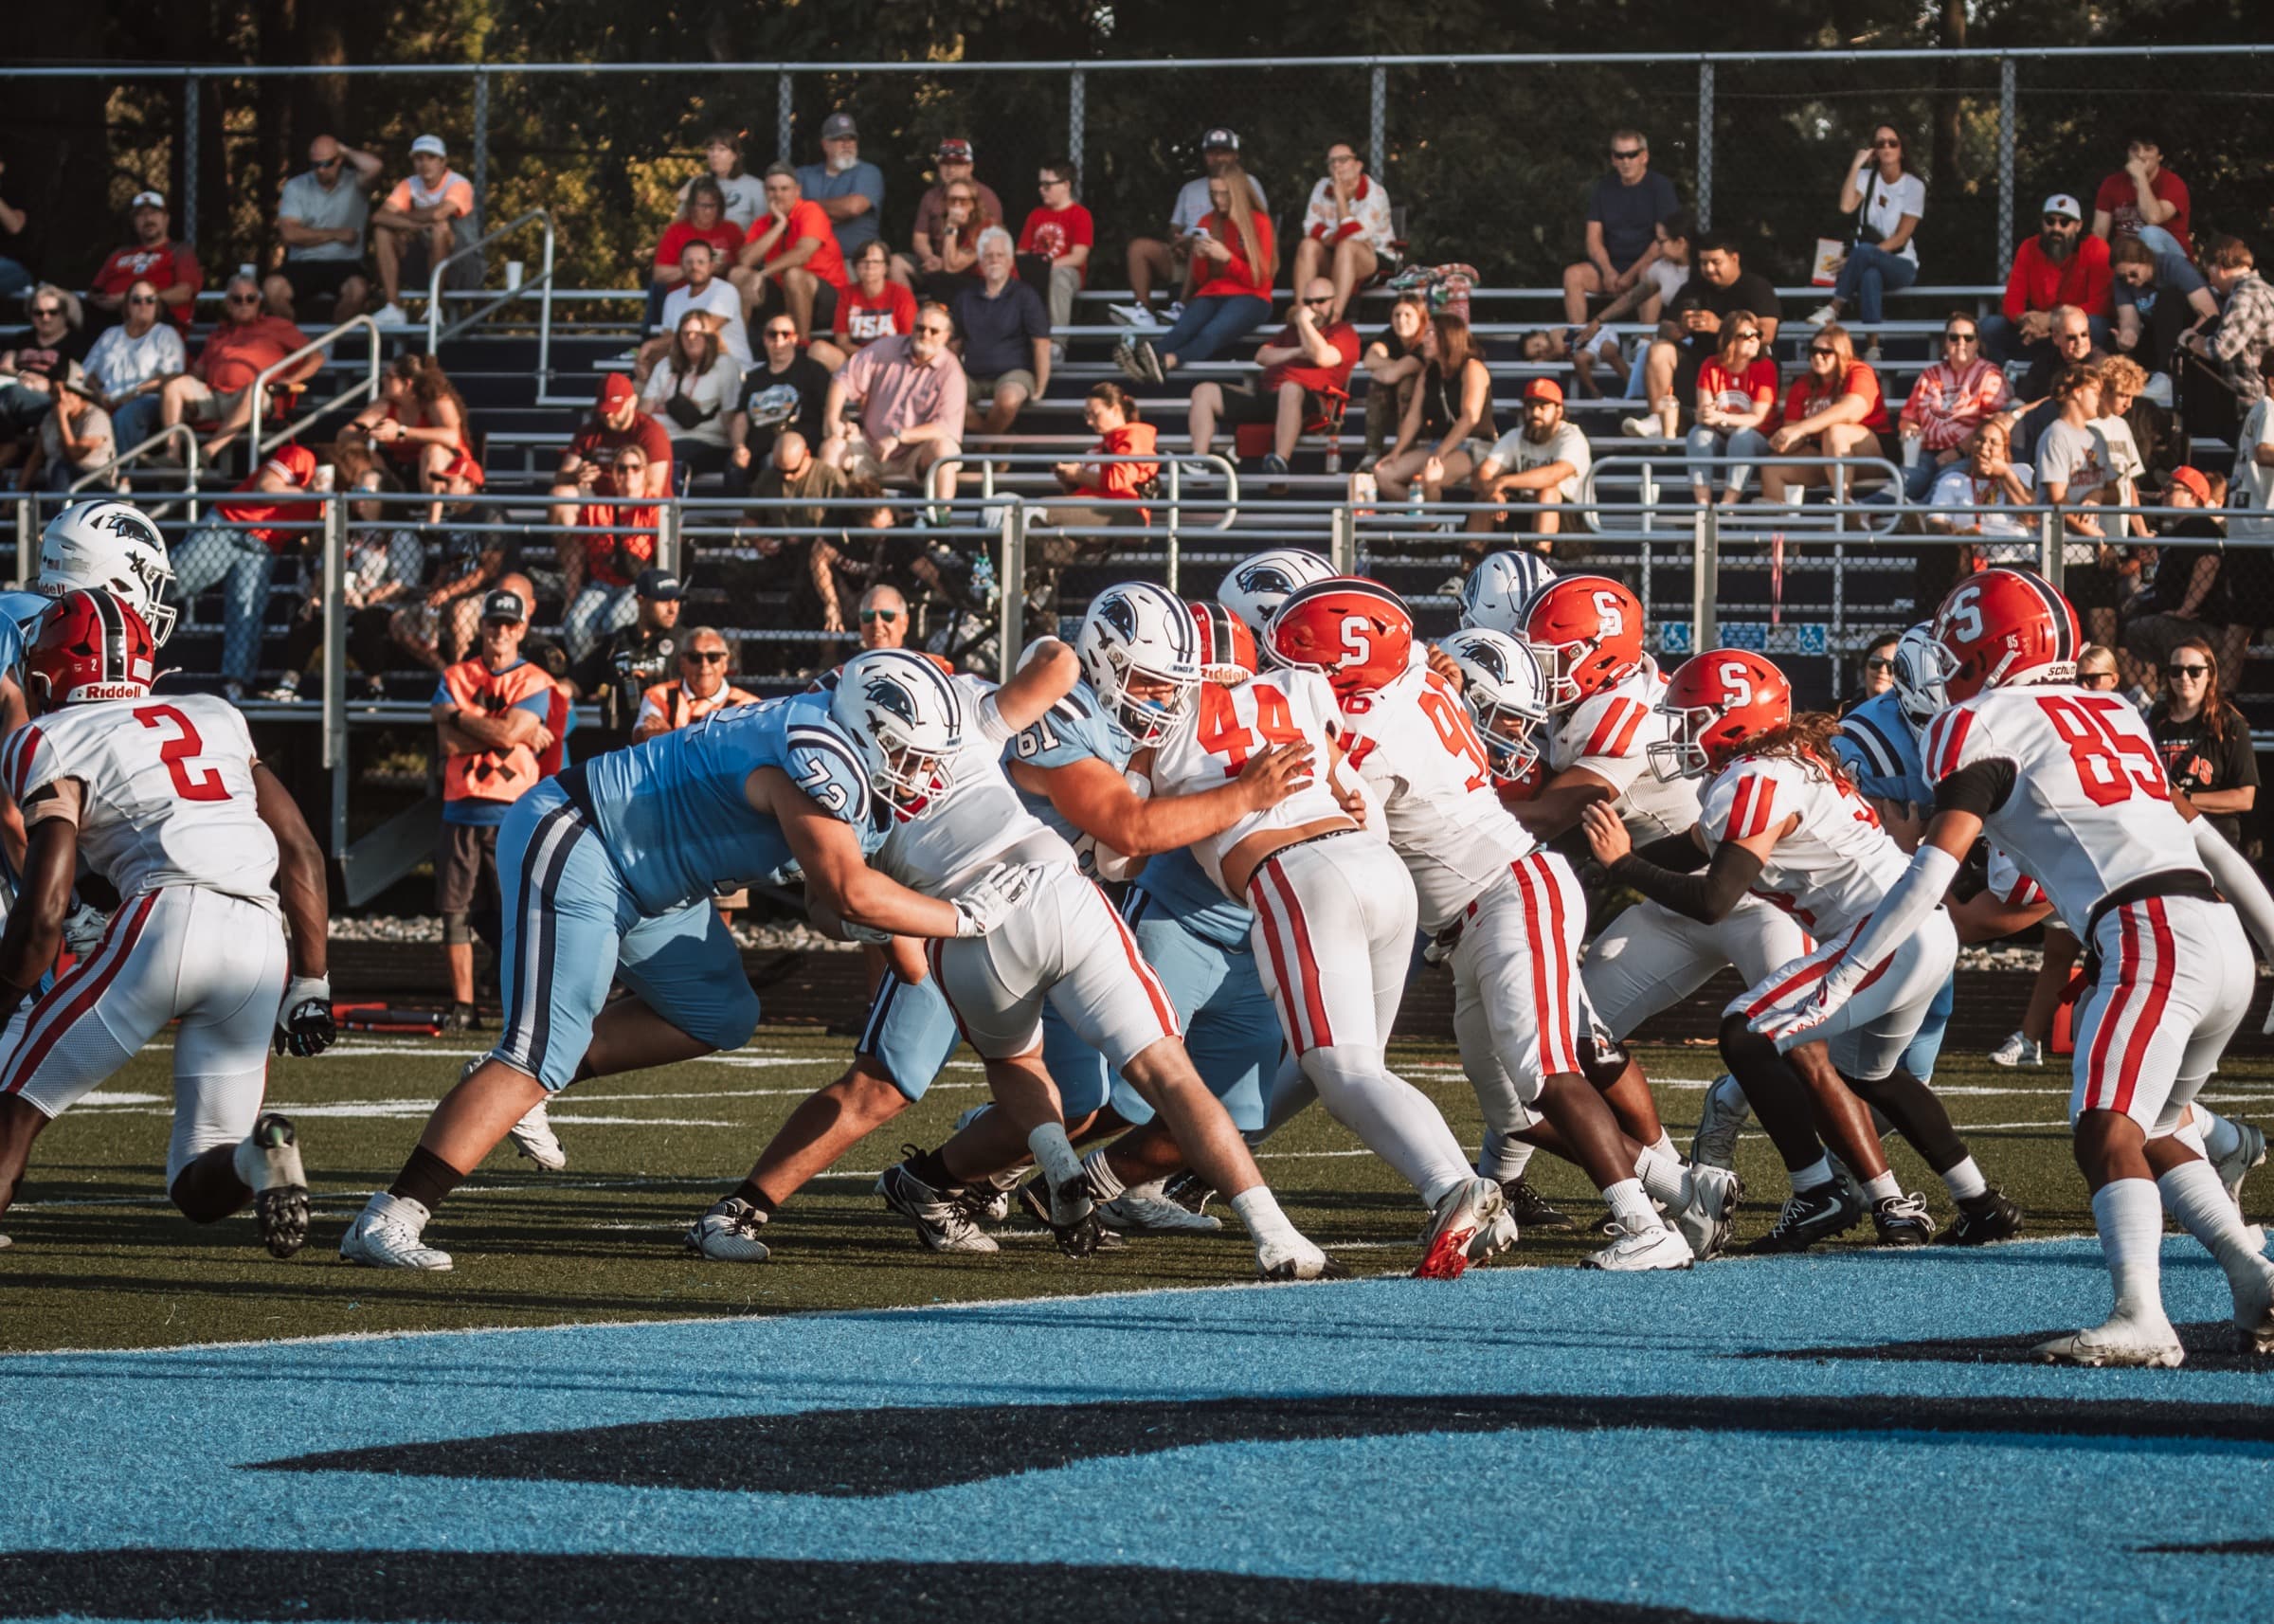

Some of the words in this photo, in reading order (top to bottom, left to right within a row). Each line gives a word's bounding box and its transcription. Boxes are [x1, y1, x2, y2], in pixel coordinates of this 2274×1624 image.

[1593, 591, 1622, 636] S
[1956, 586, 1983, 642] S
[1341, 616, 1371, 665] S
[2006, 635, 2018, 648] 85
[91, 659, 97, 672] 2
[1719, 662, 1751, 707] S
[86, 686, 141, 699] Riddell
[133, 704, 232, 801] 2
[1015, 714, 1060, 758] 61
[1197, 683, 1314, 778] 44
[2034, 695, 2171, 807] 85
[796, 756, 848, 812] 72
